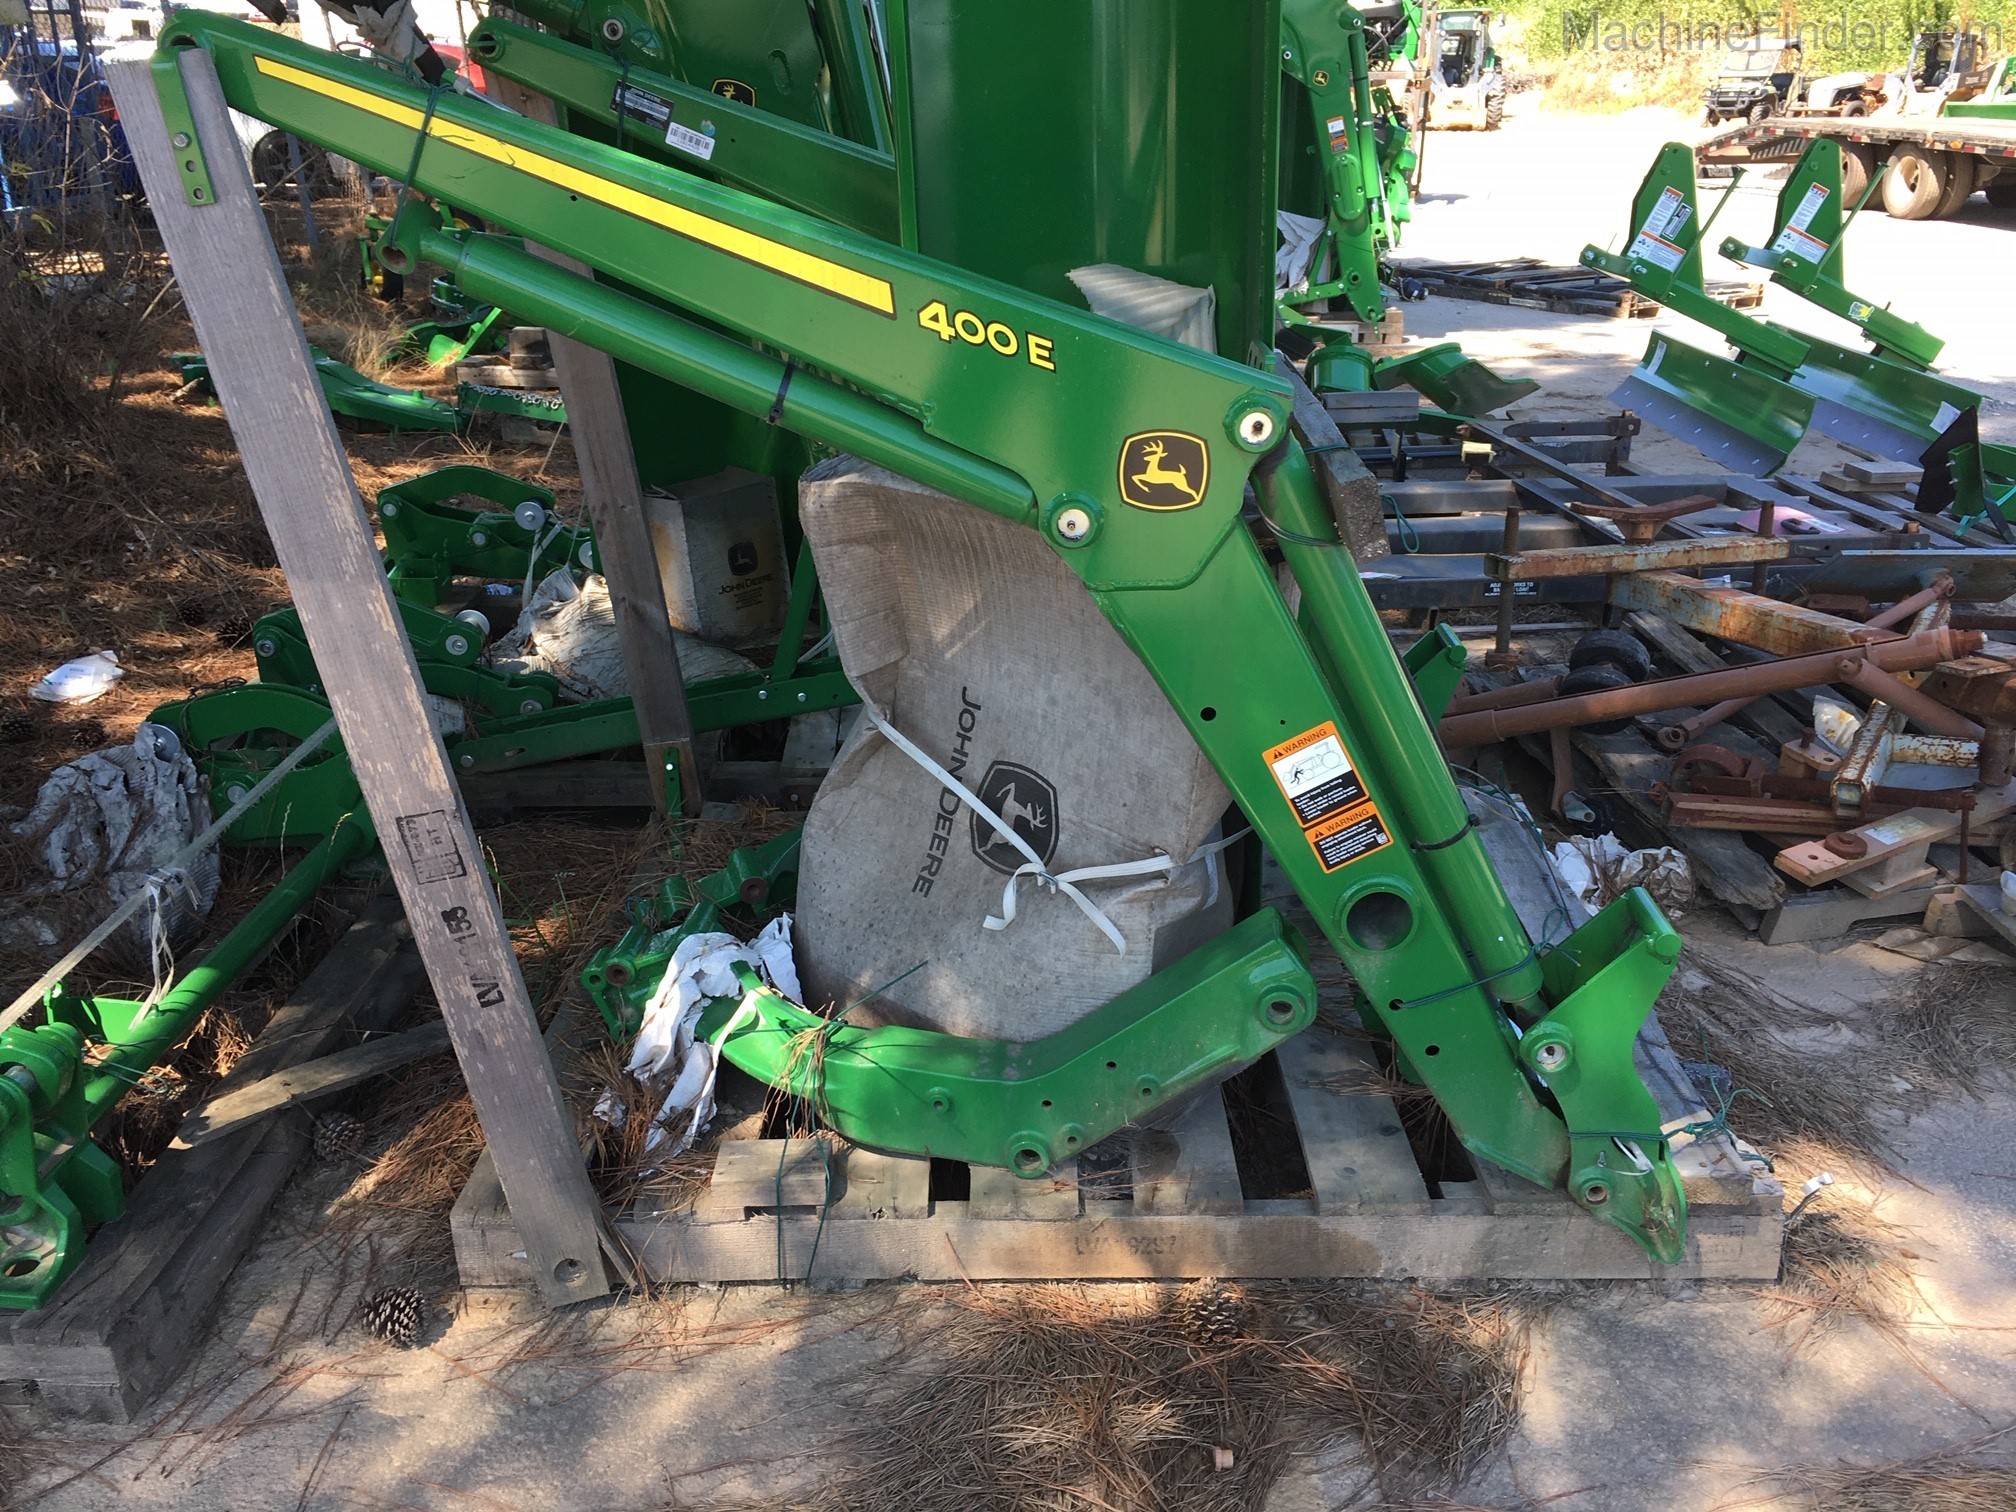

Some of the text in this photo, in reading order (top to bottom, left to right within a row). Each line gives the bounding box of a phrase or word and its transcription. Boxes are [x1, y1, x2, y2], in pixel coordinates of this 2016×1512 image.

[917, 299, 1057, 373] 400 E
[1282, 728, 1328, 755] WARNING
[911, 686, 982, 898] JOHN DEERE
[1325, 807, 1370, 833] WARNING
